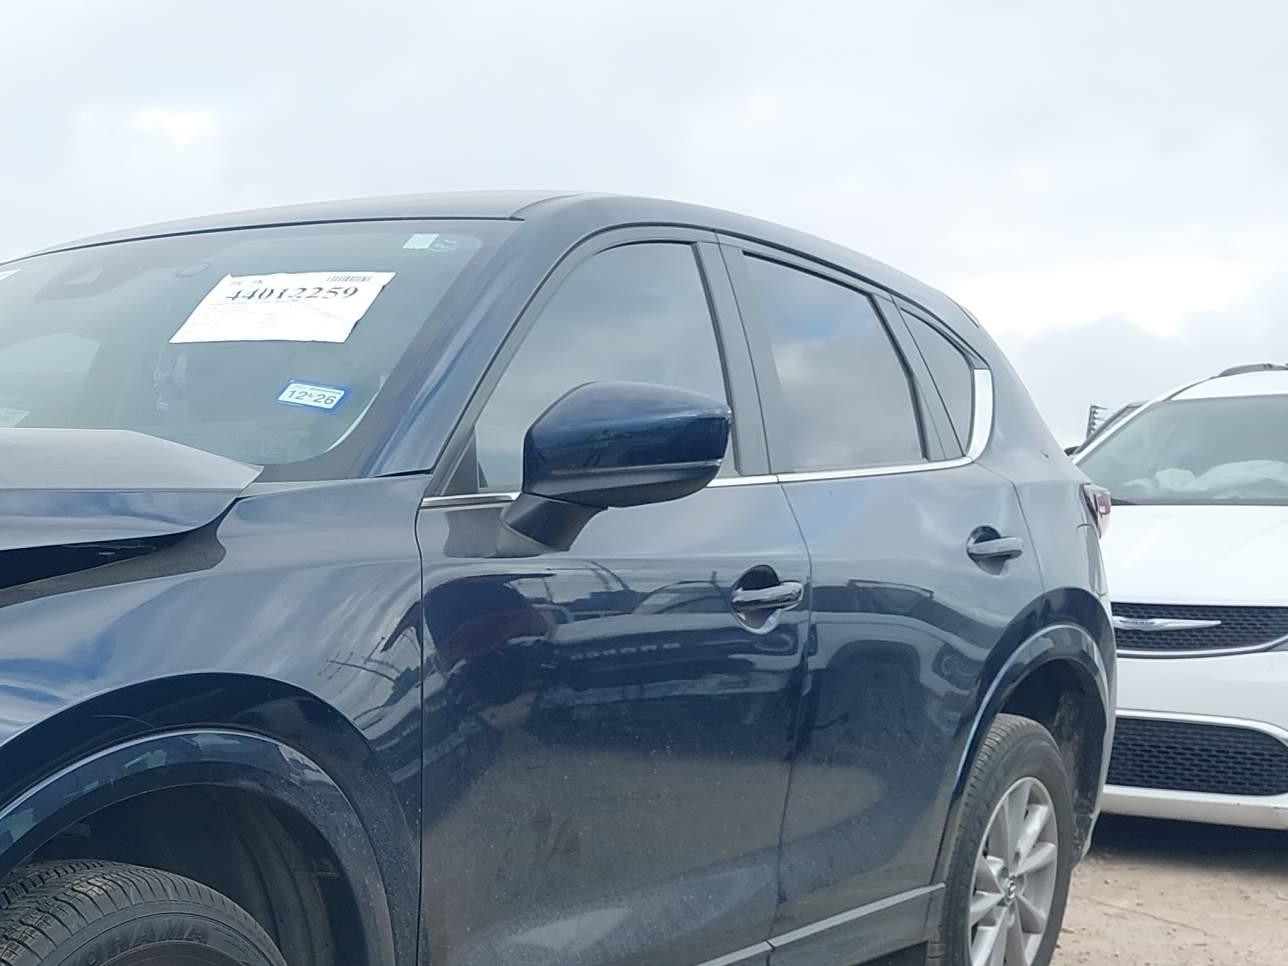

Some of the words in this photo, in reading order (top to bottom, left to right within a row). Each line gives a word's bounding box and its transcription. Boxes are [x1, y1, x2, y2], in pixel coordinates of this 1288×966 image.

[226, 286, 359, 300] 44012259
[288, 389, 309, 401] 12
[313, 392, 337, 405] 26
